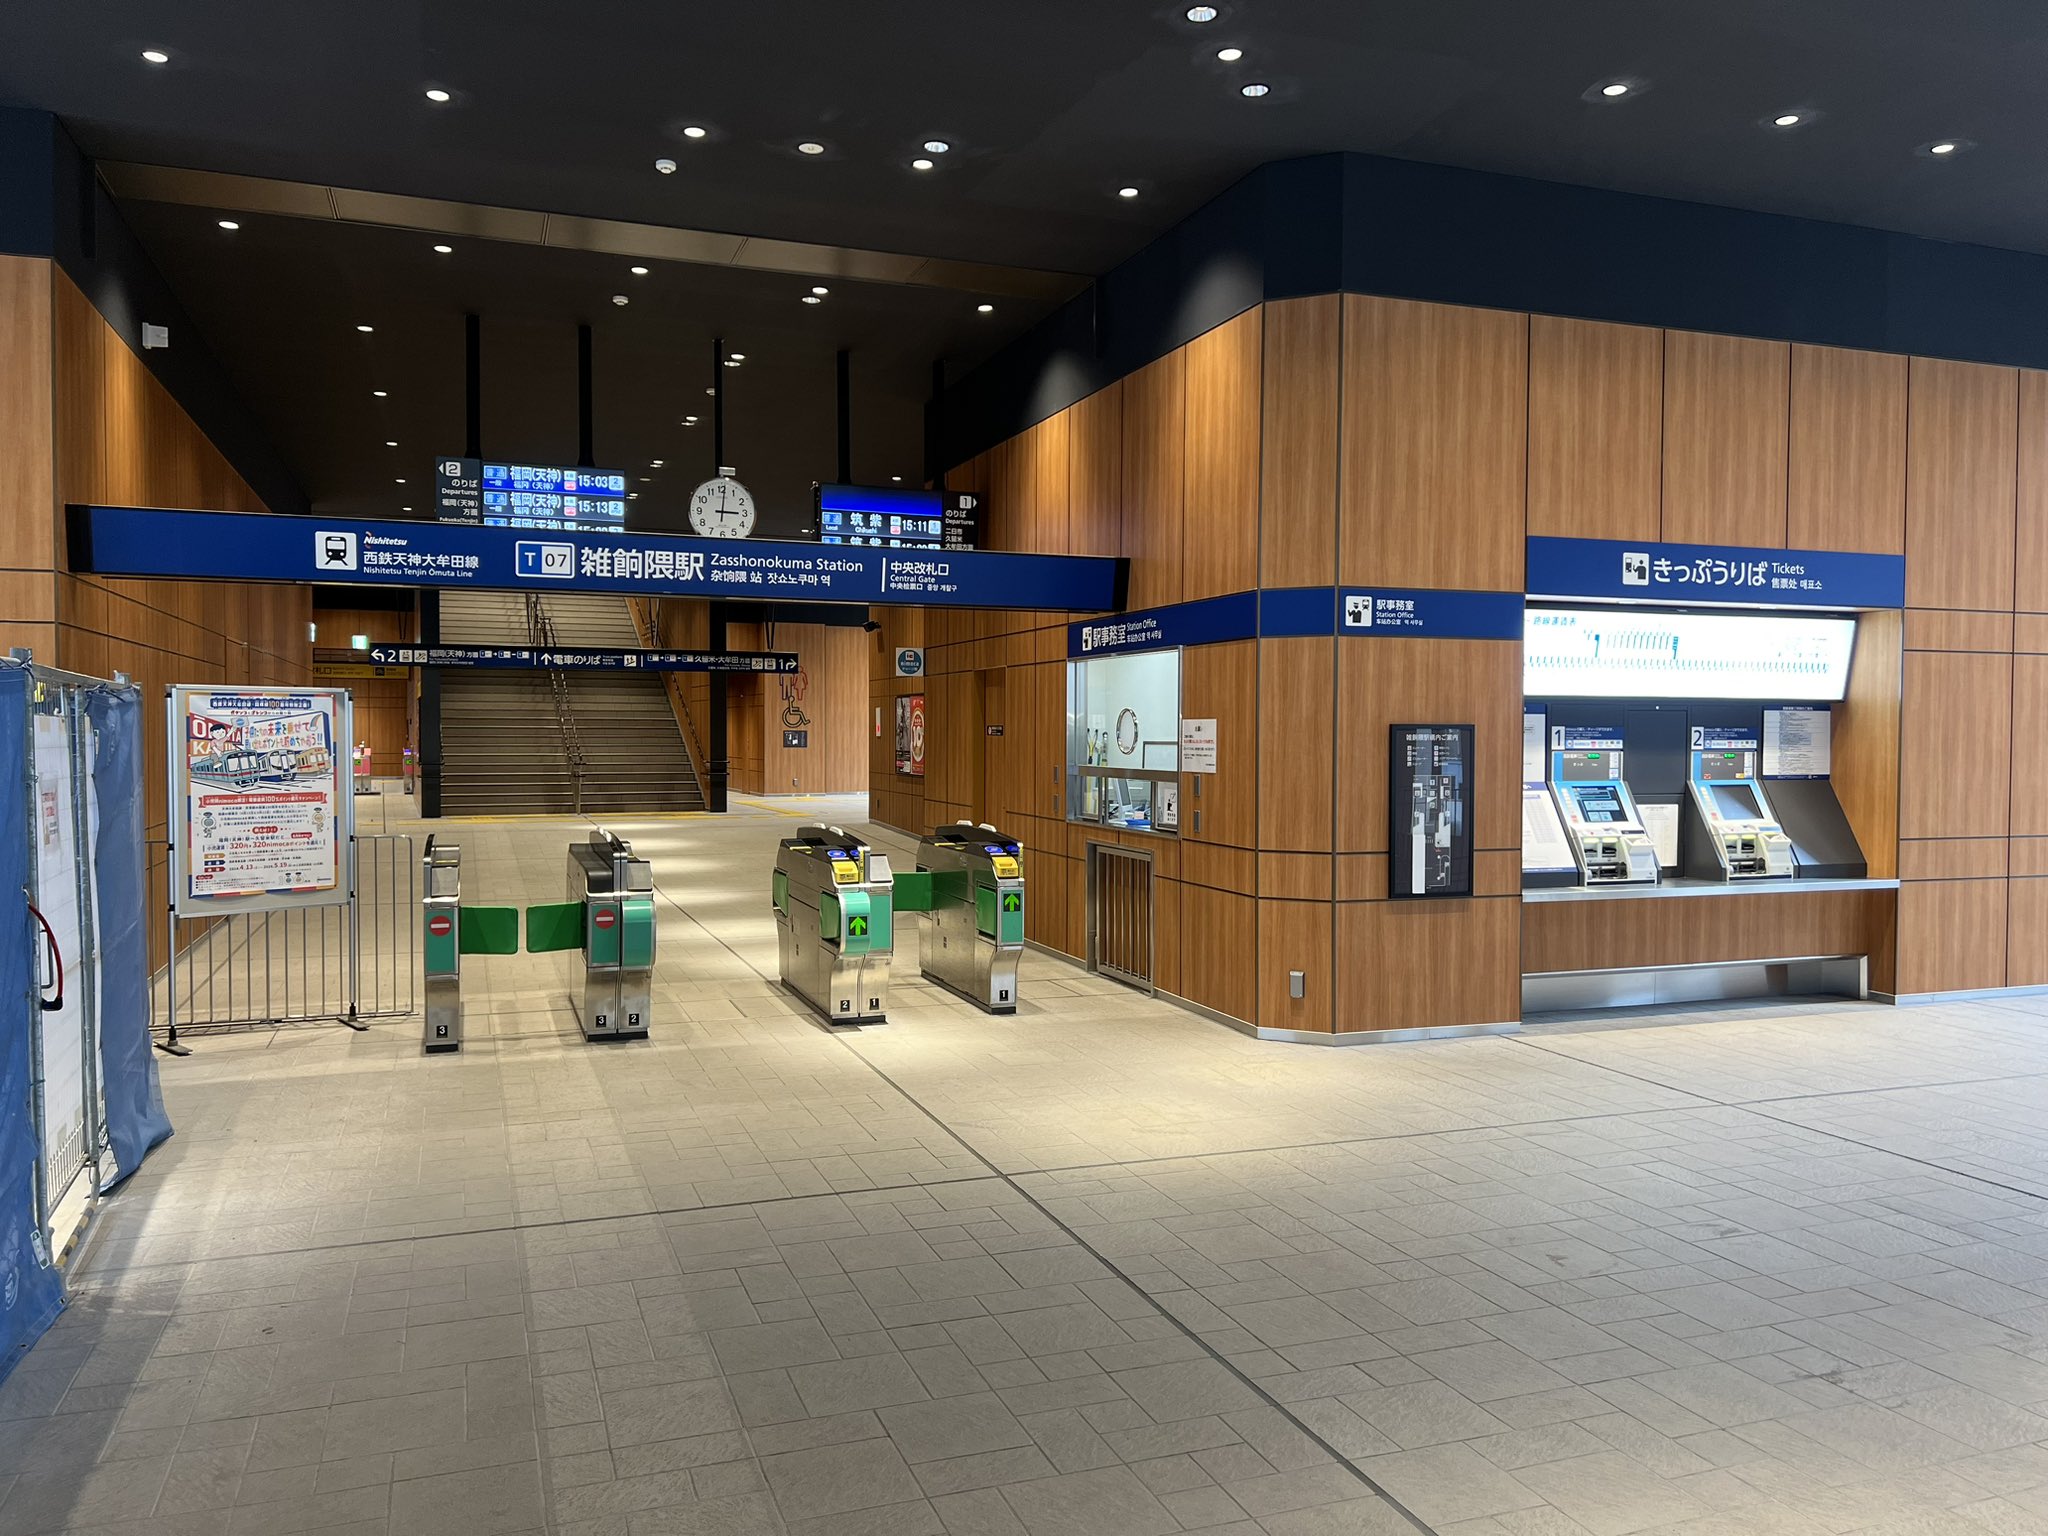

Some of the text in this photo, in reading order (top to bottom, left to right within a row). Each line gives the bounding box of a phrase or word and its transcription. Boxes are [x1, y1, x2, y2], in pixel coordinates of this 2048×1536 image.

[448, 464, 458, 474] 2
[510, 466, 560, 482] 福岡(天神)
[578, 475, 608, 488] 15:03
[452, 479, 478, 488] のりば
[442, 498, 478, 507] 福岡(天神)
[510, 492, 560, 508] 福岡(天神)
[578, 500, 608, 514] 15:13
[902, 520, 927, 532] 15:11
[364, 536, 407, 546] Nishitetsu
[364, 552, 479, 568] 西鉄天神大牟田線
[524, 552, 568, 567] T 07
[580, 546, 704, 581] 雑餉隈駅
[711, 554, 863, 572] Zasshonokuma Station
[403, 568, 427, 577] Tenjin
[890, 561, 949, 576] 中央改札口
[1653, 558, 1768, 586] きっぷうりば
[1771, 563, 1805, 575] Tickets
[750, 571, 762, 584] 站
[768, 572, 831, 586] 잣쇼노쿠마 역
[890, 574, 917, 582] Central
[1771, 578, 1797, 590] 售票处
[1800, 580, 1822, 590] 매표소
[1376, 599, 1414, 611] 駅事務室
[1127, 618, 1157, 632] Station Office
[1093, 624, 1126, 648] 駅事務室
[387, 650, 396, 662] 2
[553, 654, 601, 665] 電車のりば
[779, 659, 784, 670] 1
[1555, 729, 1560, 746] 1
[1693, 730, 1702, 746] 2
[841, 1001, 848, 1009] 2
[598, 1016, 604, 1024] 3
[631, 1015, 637, 1023] 2
[438, 1026, 446, 1035] 3
